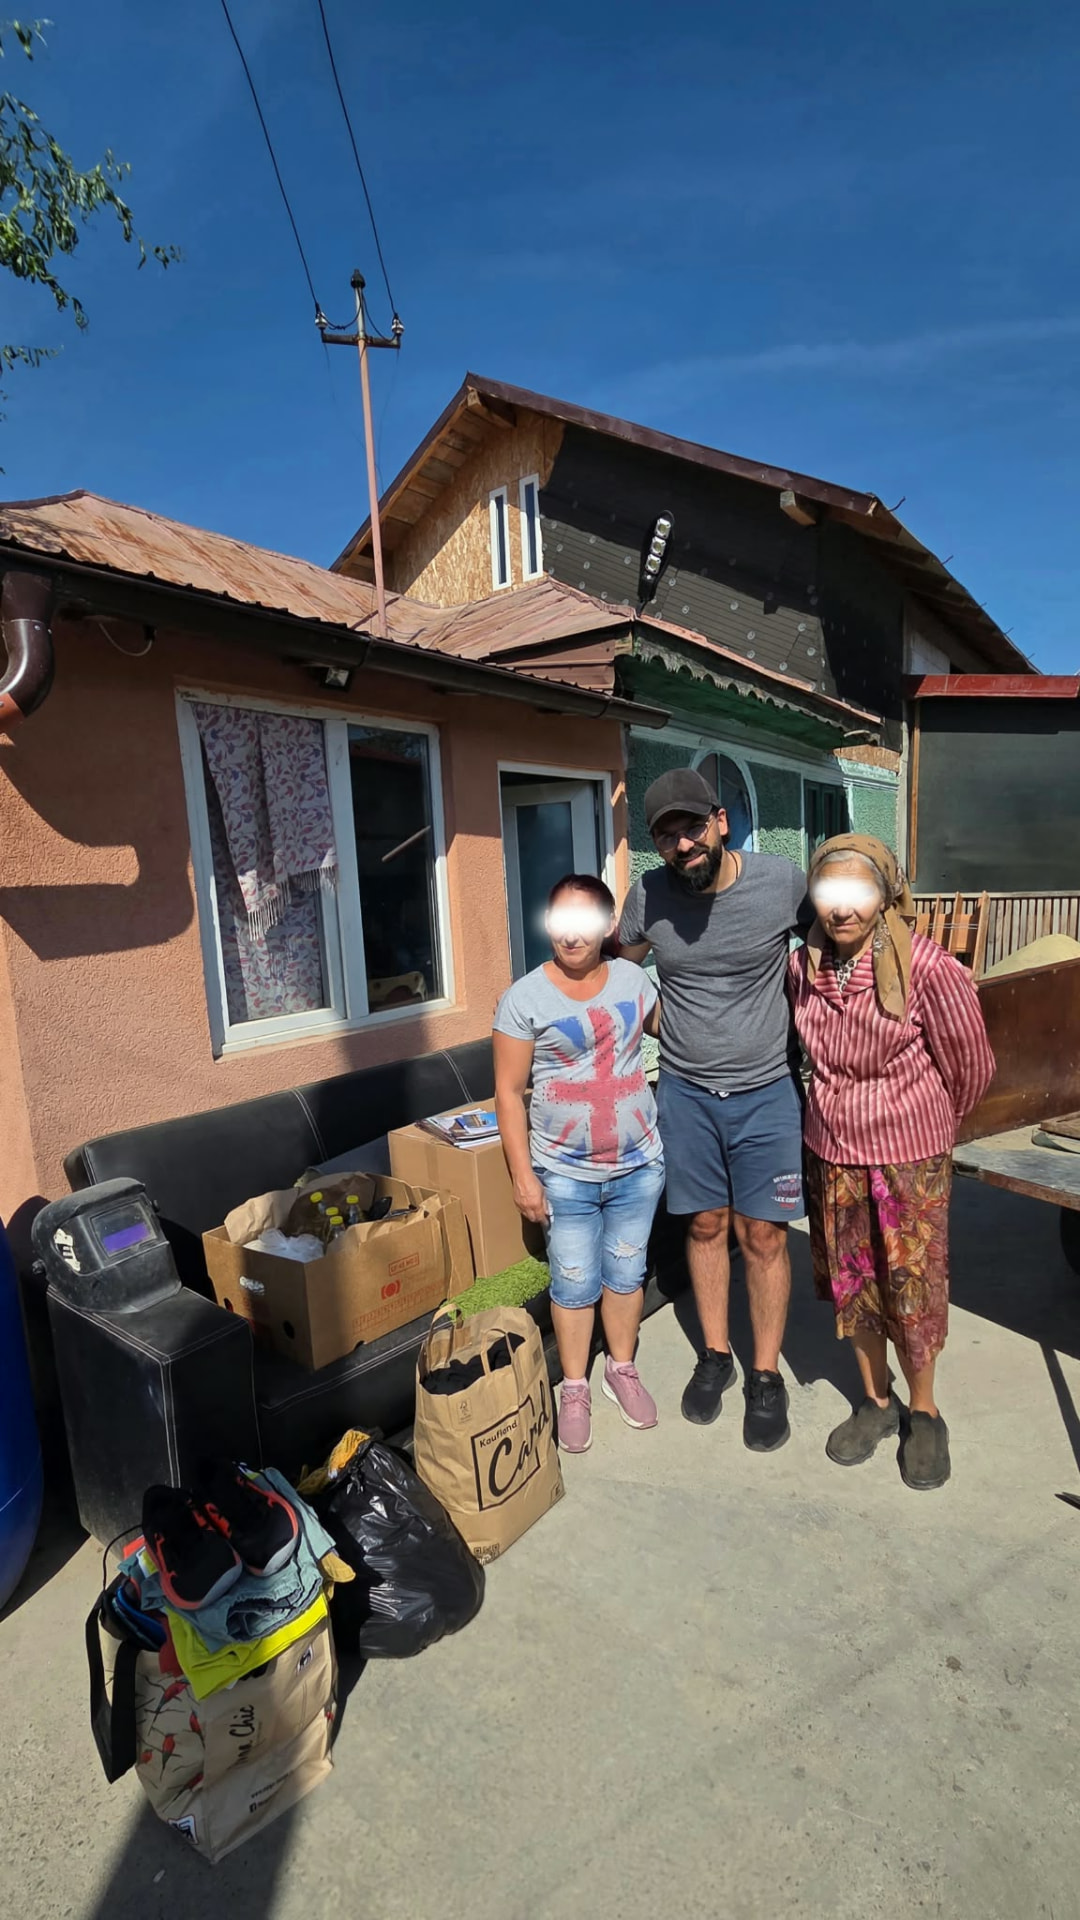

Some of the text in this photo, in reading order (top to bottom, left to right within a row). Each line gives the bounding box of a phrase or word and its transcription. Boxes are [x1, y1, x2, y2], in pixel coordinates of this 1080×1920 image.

[479, 1419, 518, 1448] Kaufland
[488, 1379, 549, 1497] Card
[228, 1704, 255, 1738] Chic
